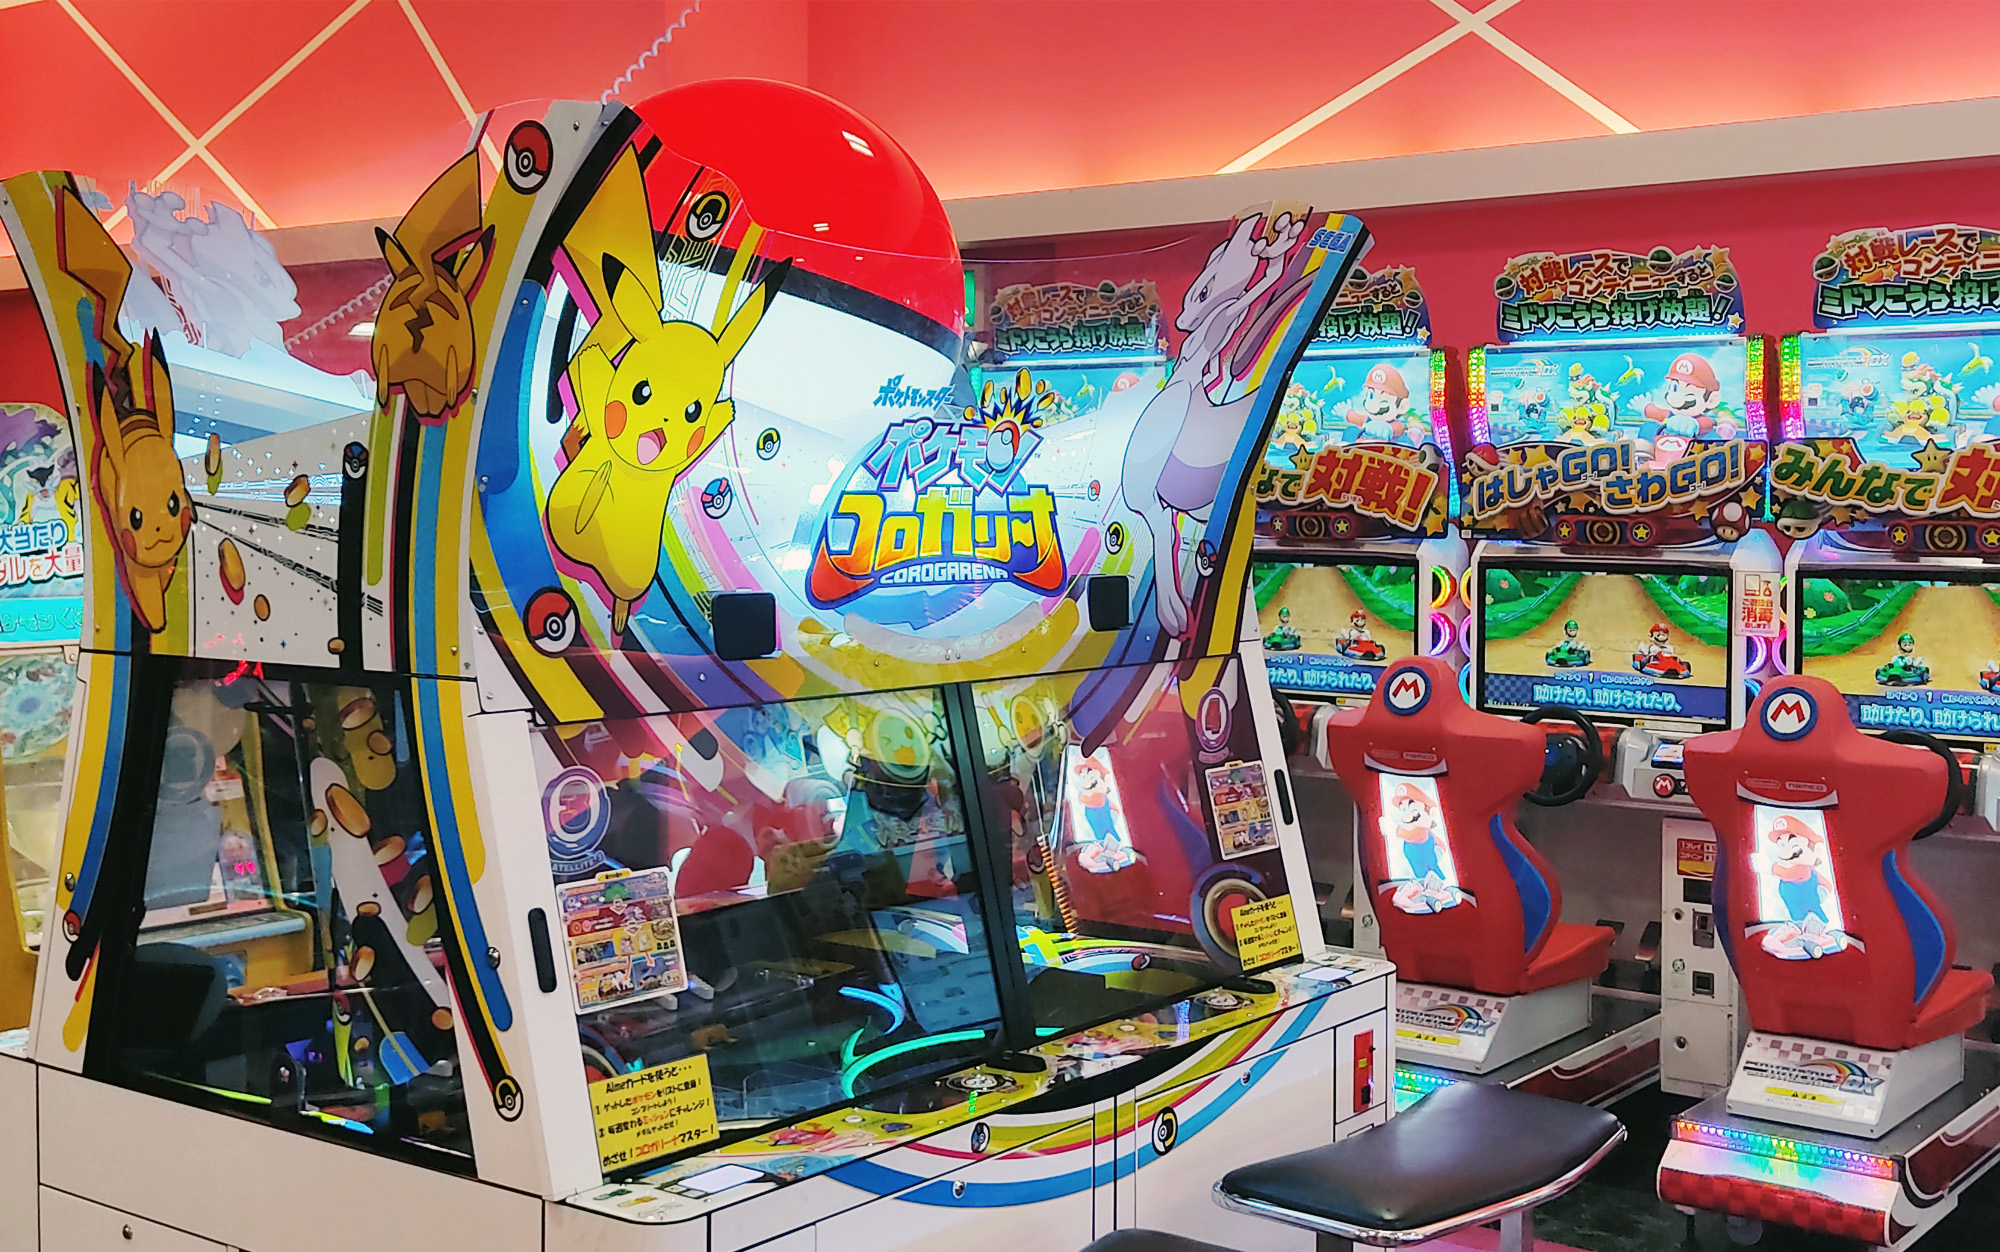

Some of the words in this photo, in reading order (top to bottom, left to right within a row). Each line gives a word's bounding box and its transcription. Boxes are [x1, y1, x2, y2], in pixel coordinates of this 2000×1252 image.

[1308, 228, 1353, 253] SEGA
[1845, 228, 1978, 277] 対戦レースで
[1520, 252, 1633, 292] 対戦レースで
[1567, 264, 1714, 297] コンティニューすると
[1502, 293, 1733, 331] ミドリこうら投げ放題!
[865, 418, 1044, 496] ポケモン
[1605, 443, 1740, 507] さわGO!
[1478, 443, 1632, 514] はしゃGO!
[808, 485, 1066, 603] コロガリーナ
[879, 561, 1009, 586] COROGARENA
[1391, 678, 1421, 700] M
[1770, 699, 1806, 724] M
